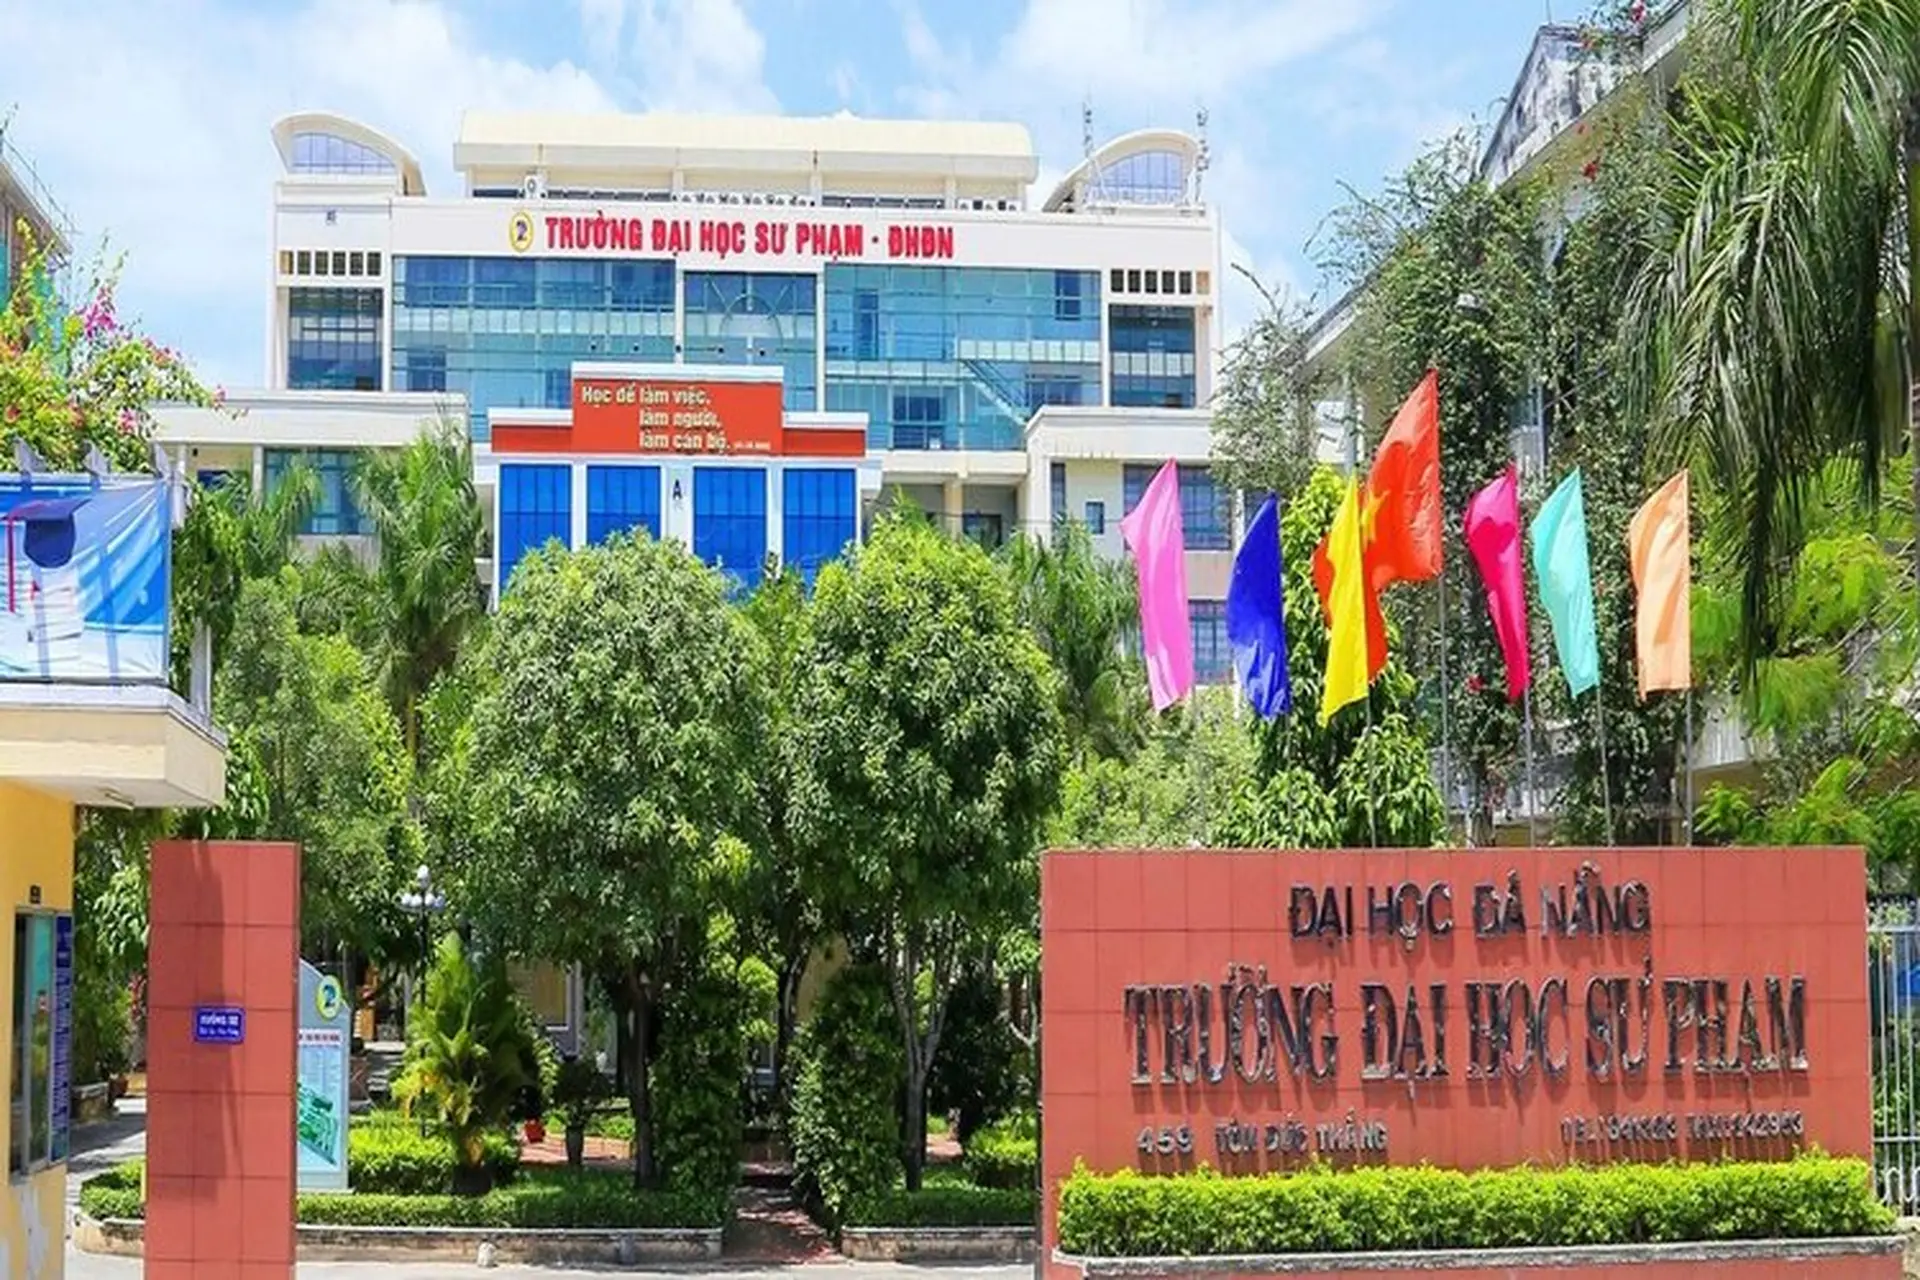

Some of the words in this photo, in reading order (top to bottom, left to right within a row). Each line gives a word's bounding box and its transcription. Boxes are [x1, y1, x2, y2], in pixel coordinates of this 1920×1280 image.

[545, 210, 642, 251] TRƯỜNG
[652, 219, 691, 257] ĐẠI
[700, 220, 745, 259] HỌC
[755, 221, 788, 254] SƯ
[795, 222, 864, 261] PHẠM
[888, 225, 954, 259] ĐHĐN
[582, 386, 612, 408] Học
[616, 382, 636, 404] để
[640, 386, 669, 404] làm
[639, 409, 669, 427] làm
[639, 431, 669, 449] làm
[673, 431, 701, 449] cán
[1288, 883, 1353, 948] ĐẠI
[1367, 881, 1455, 949] HỌC
[1123, 961, 1340, 1085] TRƯỜNG
